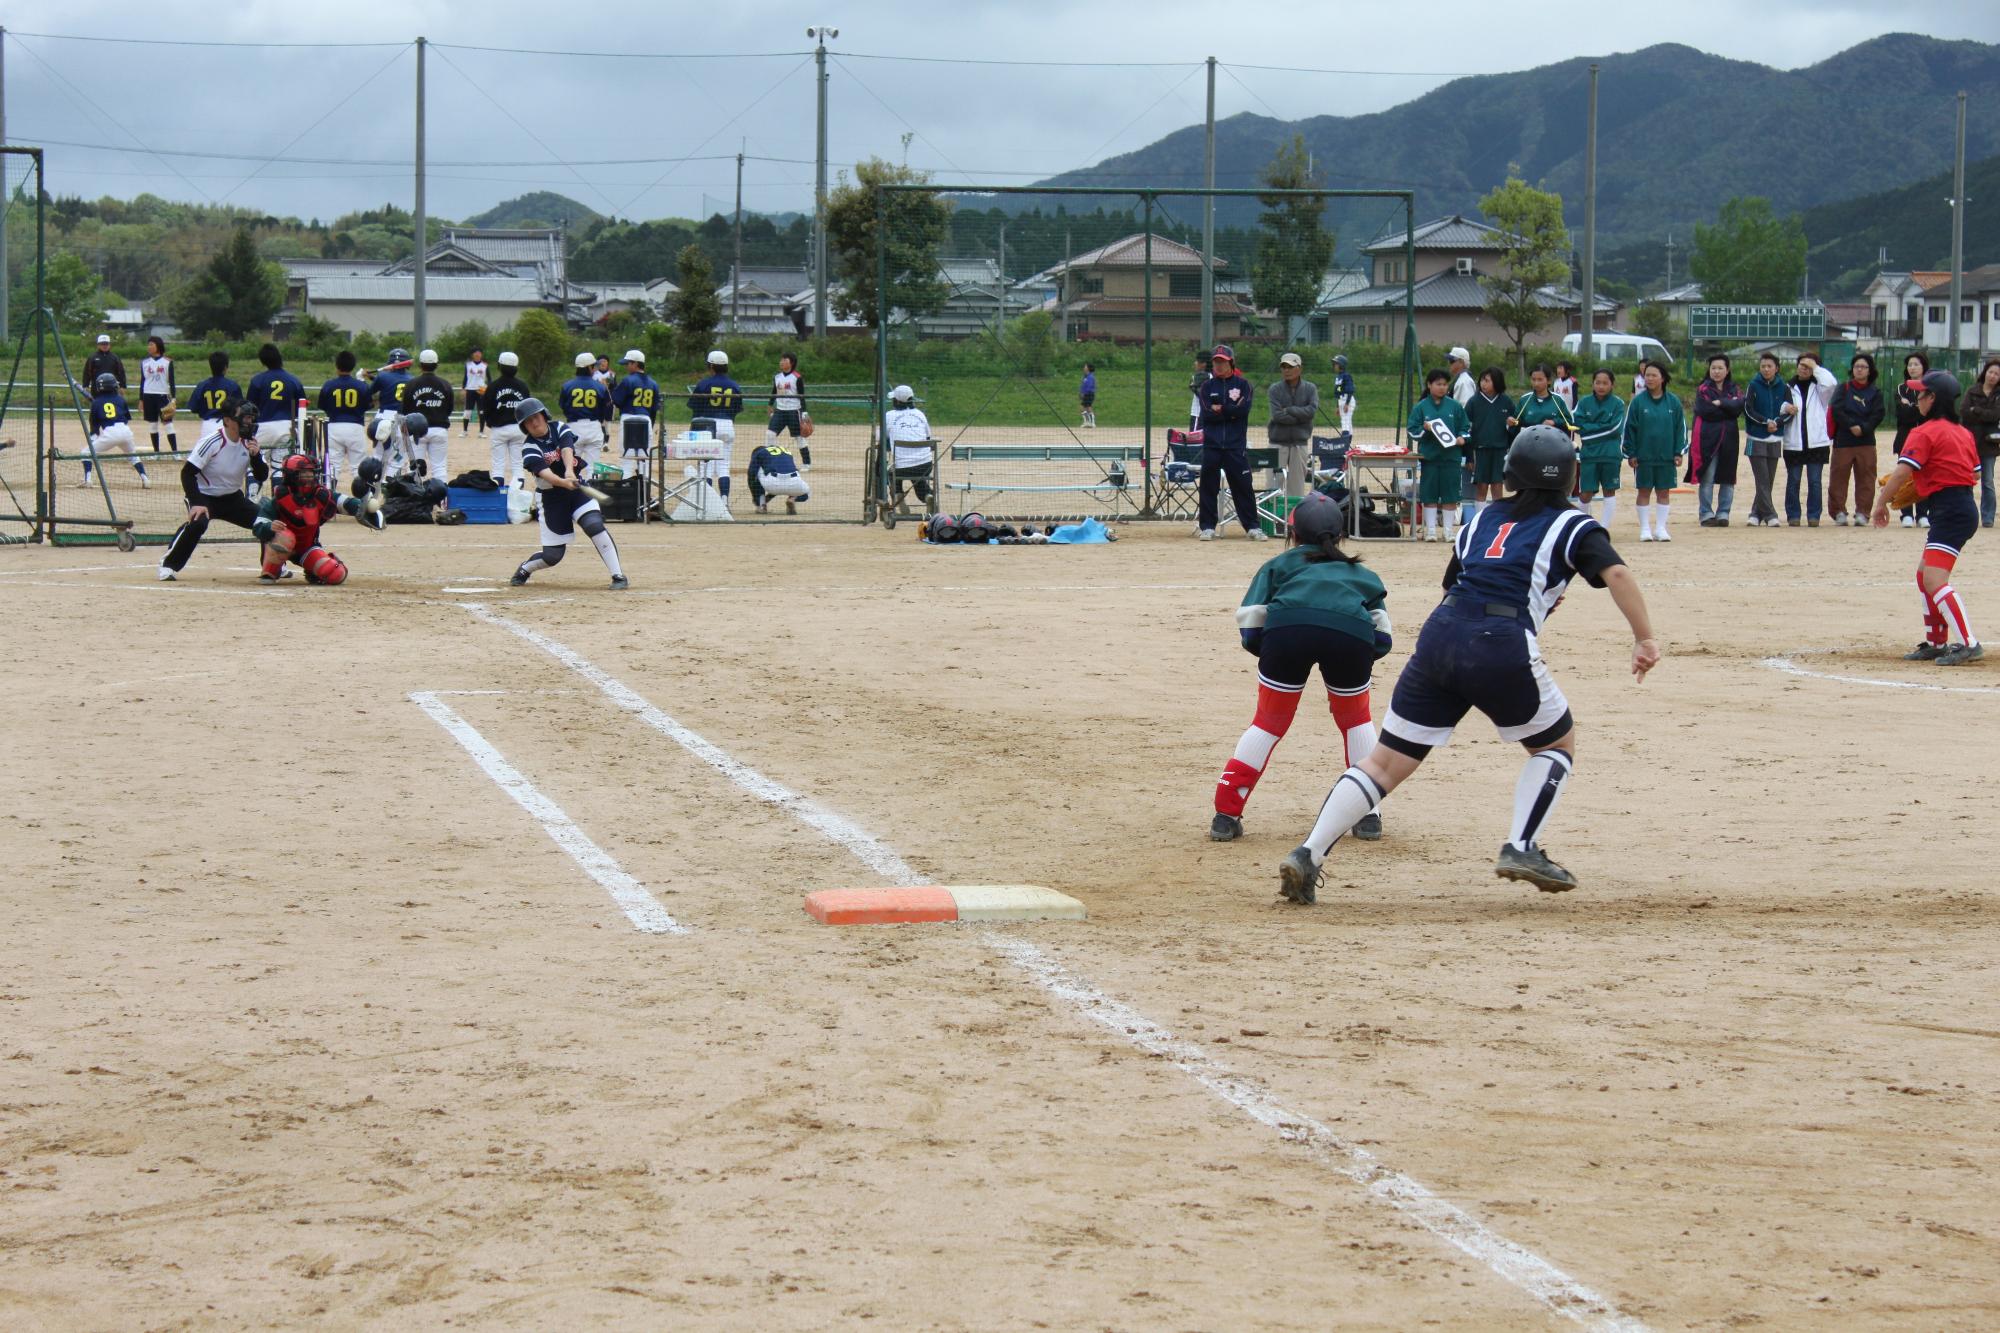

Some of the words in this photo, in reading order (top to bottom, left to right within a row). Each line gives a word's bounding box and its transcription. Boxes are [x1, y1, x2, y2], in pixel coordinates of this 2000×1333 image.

[203, 389, 227, 410] 12
[270, 380, 284, 400] 2
[332, 388, 358, 408] 10
[571, 387, 598, 408] 26
[632, 387, 654, 408] 28
[709, 386, 733, 407] 51
[103, 402, 116, 418] 9
[496, 400, 521, 410] P-CLU
[1431, 421, 1453, 443] 6
[1541, 465, 1559, 474] JSA
[1484, 521, 1518, 558] 1
